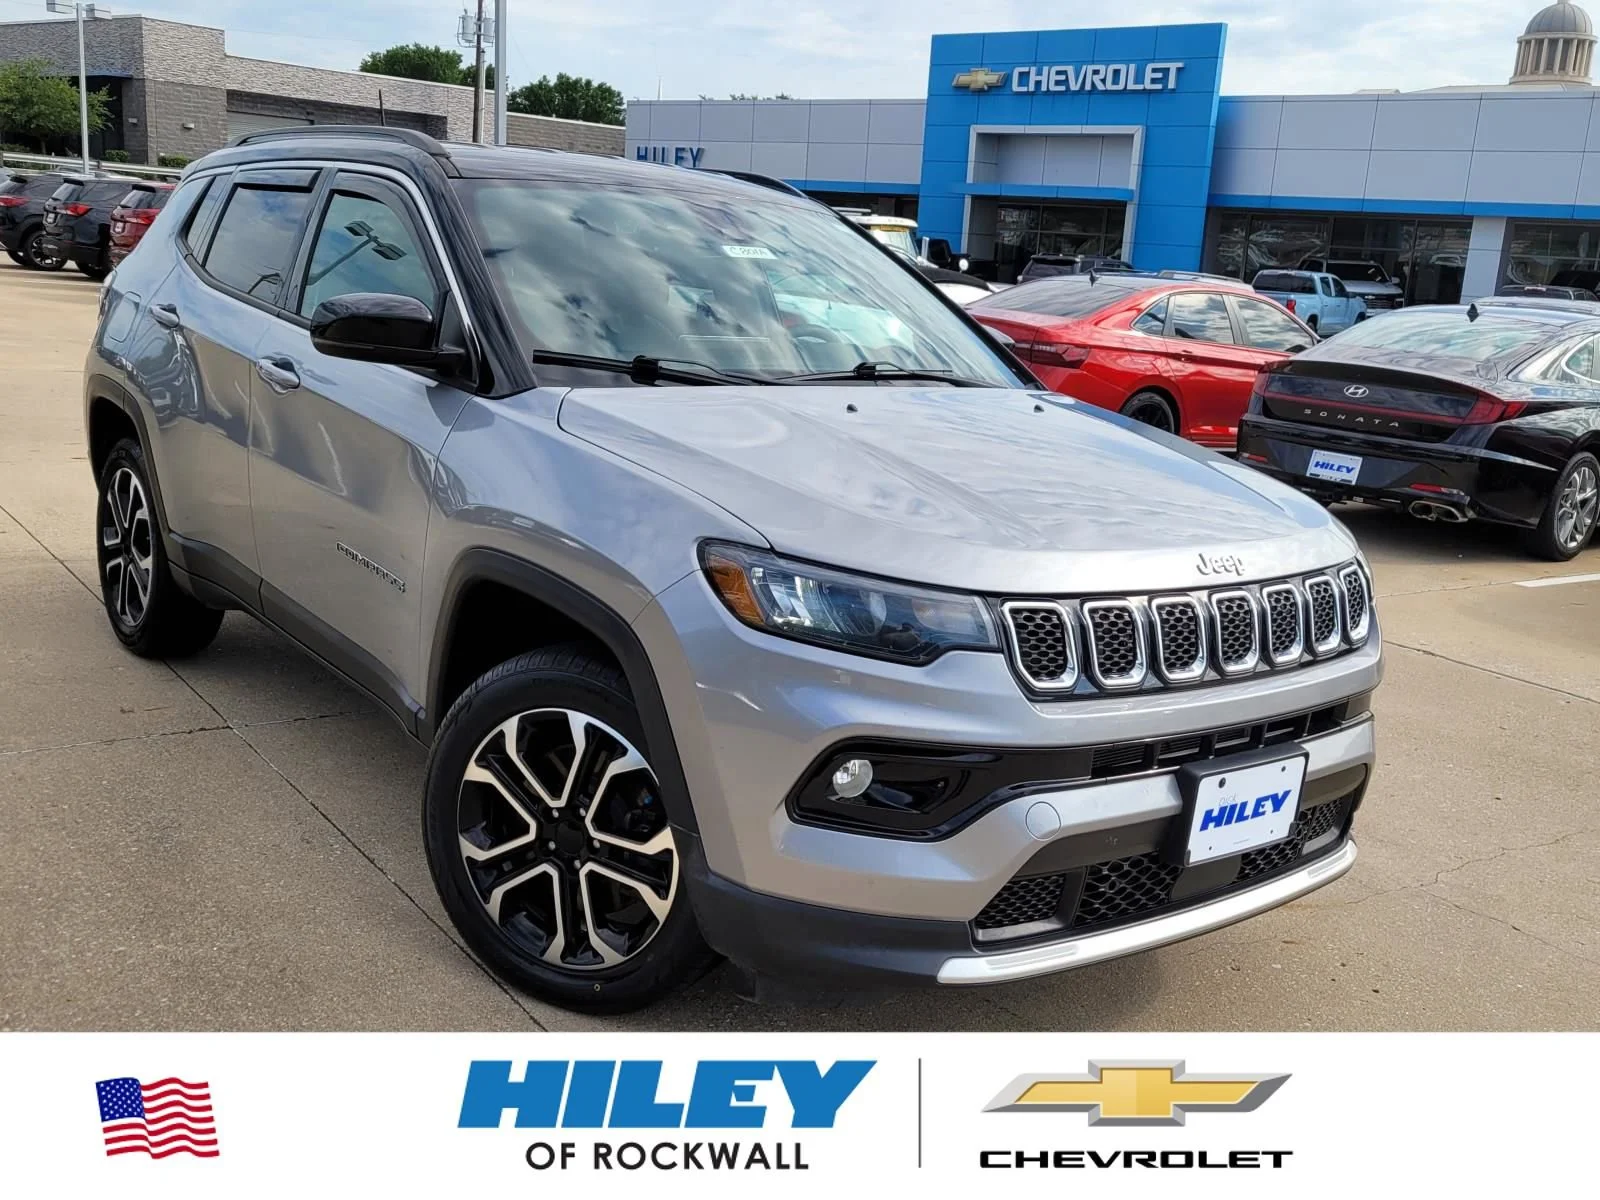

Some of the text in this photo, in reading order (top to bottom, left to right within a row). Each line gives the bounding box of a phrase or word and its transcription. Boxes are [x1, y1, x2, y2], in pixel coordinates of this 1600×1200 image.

[1012, 62, 1185, 92] CHEVROLET
[1303, 408, 1400, 427] SONATA
[1314, 460, 1356, 474] HILEY
[336, 541, 406, 593] COMPASS
[1195, 552, 1245, 577] Jeep
[1199, 789, 1292, 833] HILEY
